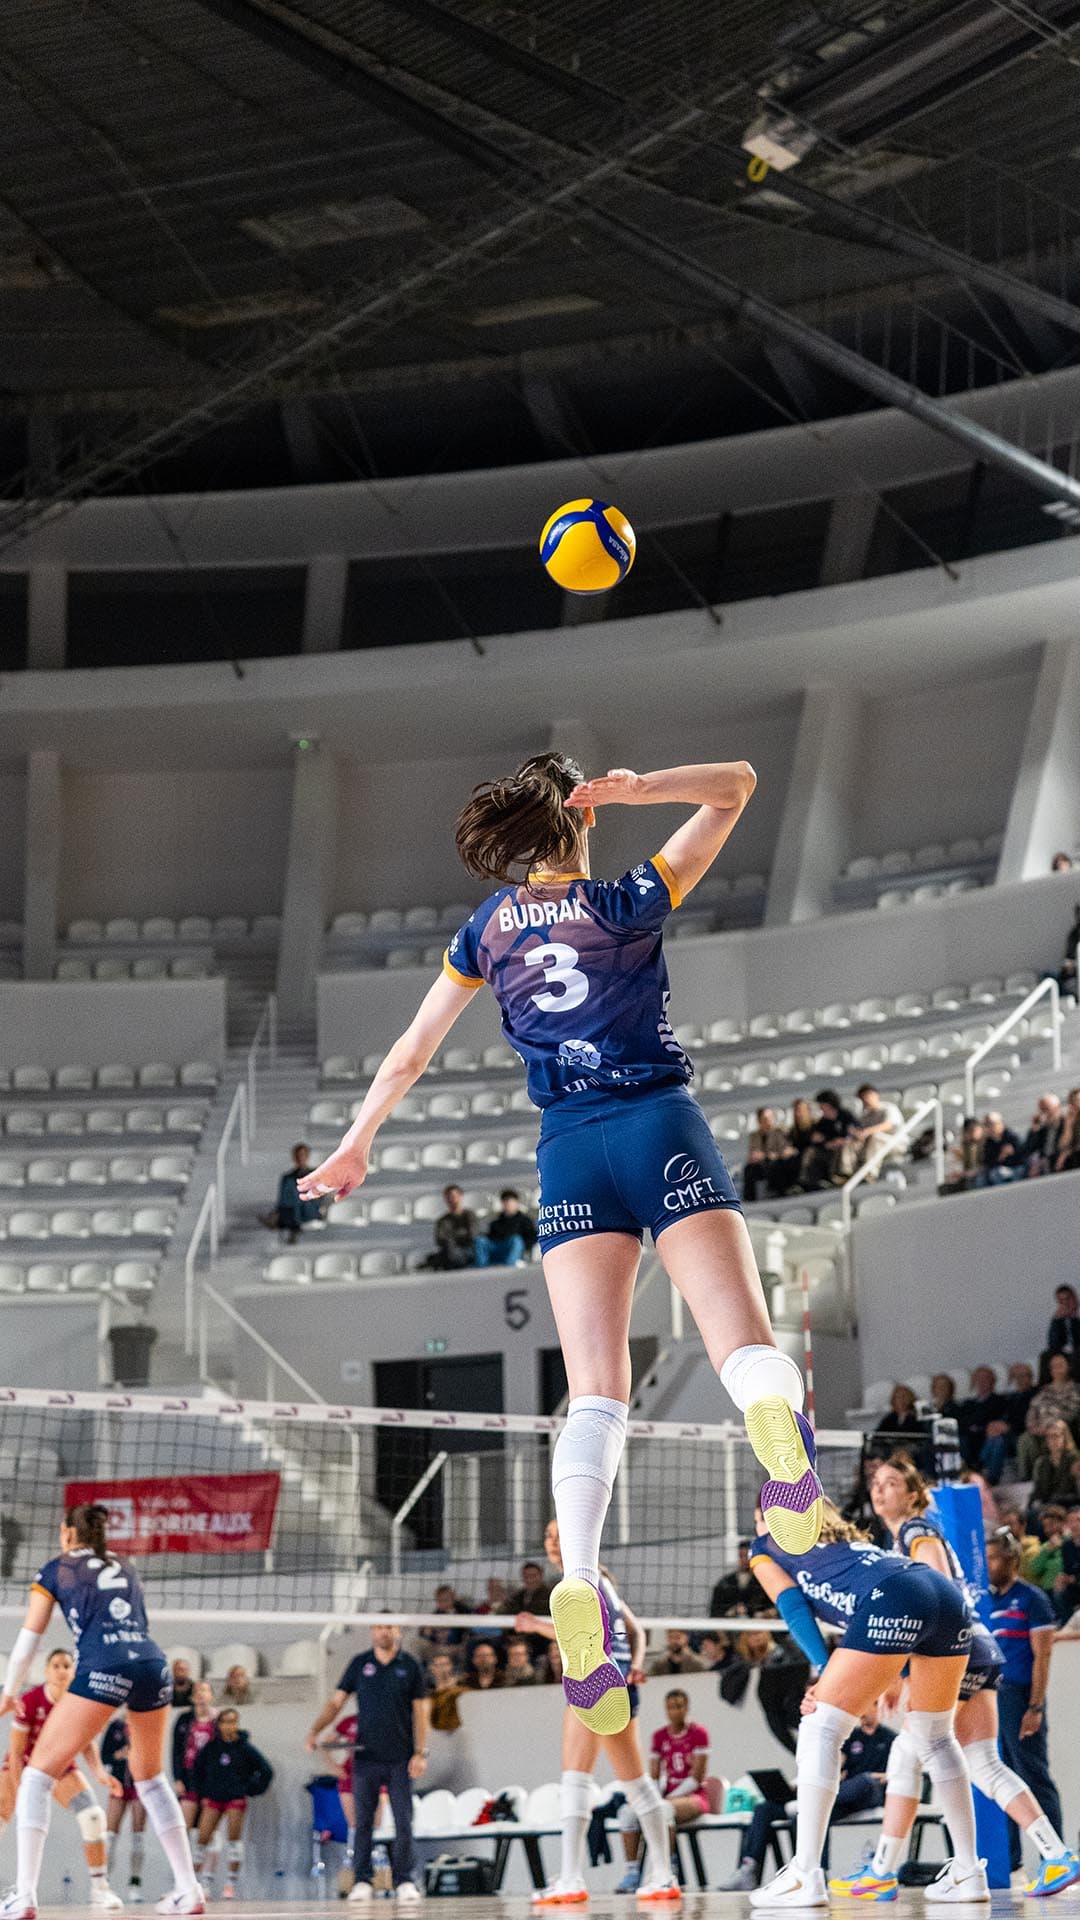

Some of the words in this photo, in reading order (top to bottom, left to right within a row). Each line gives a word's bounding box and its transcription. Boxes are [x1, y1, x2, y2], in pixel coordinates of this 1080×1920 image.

[498, 898, 590, 932] BUDRAK
[524, 942, 589, 1012] 3
[663, 1177, 714, 1210] CMFT
[537, 1219, 593, 1236] nation
[504, 1290, 531, 1330] 5
[140, 1512, 252, 1538] BORDEAUX
[87, 1558, 128, 1590] 2
[867, 1614, 922, 1630] interim
[867, 1628, 917, 1642] nation
